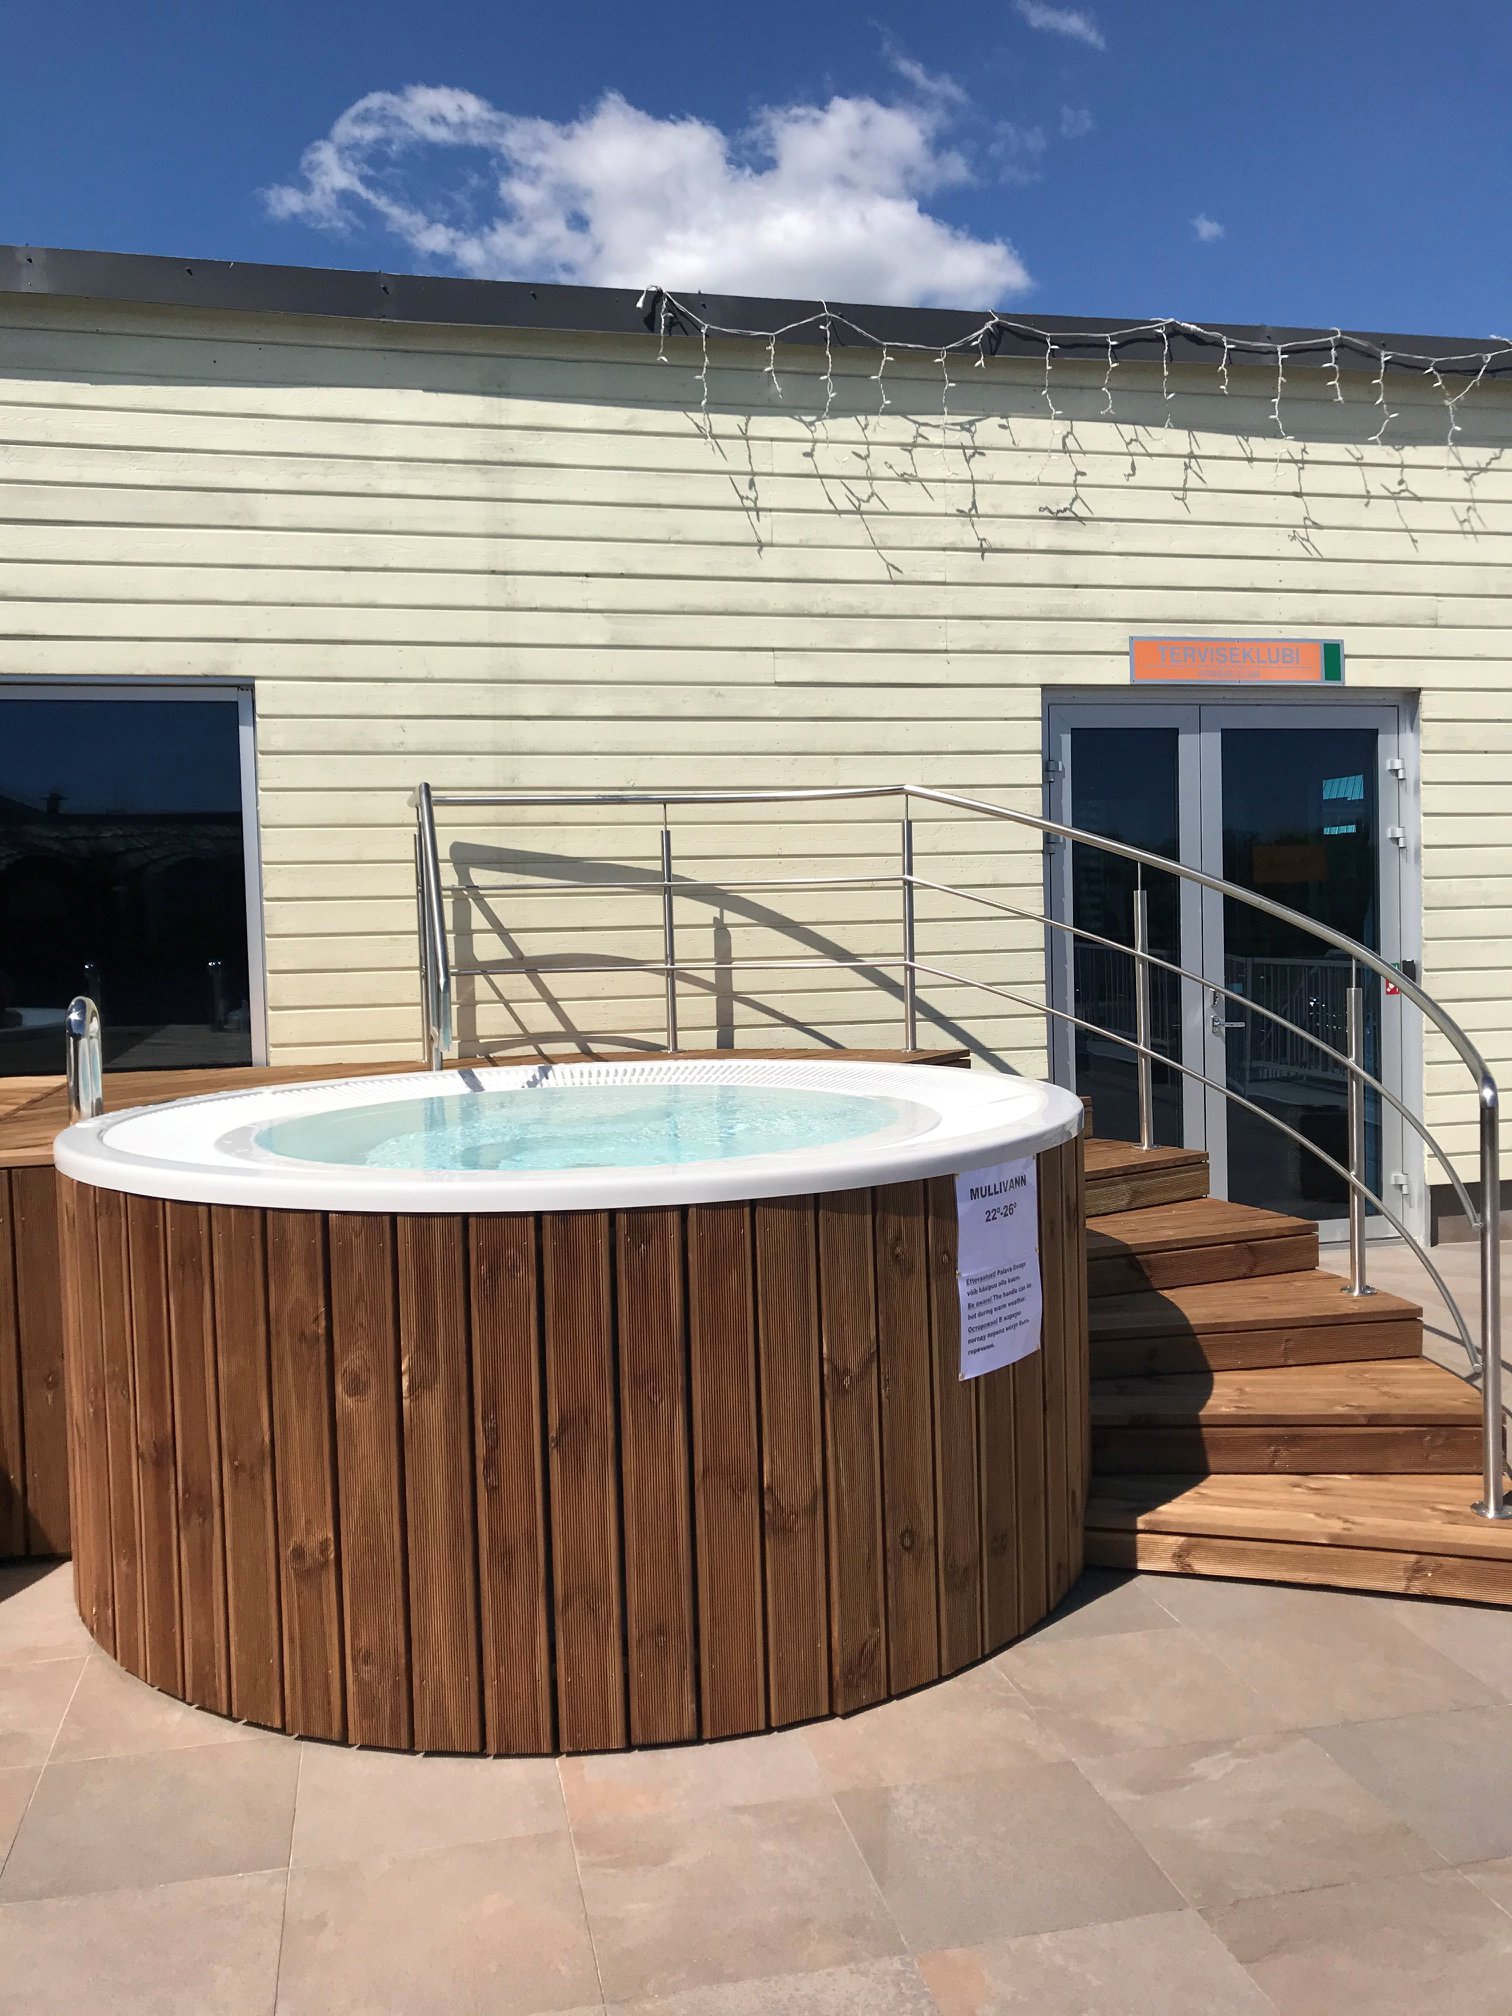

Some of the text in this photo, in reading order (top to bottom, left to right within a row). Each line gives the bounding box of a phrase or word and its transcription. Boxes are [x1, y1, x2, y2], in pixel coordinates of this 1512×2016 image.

[1158, 645, 1300, 664] TERVISEKLUBI
[970, 1174, 1027, 1200] MULLIVANN
[968, 1302, 975, 1310] Be
[978, 1309, 993, 1318] during
